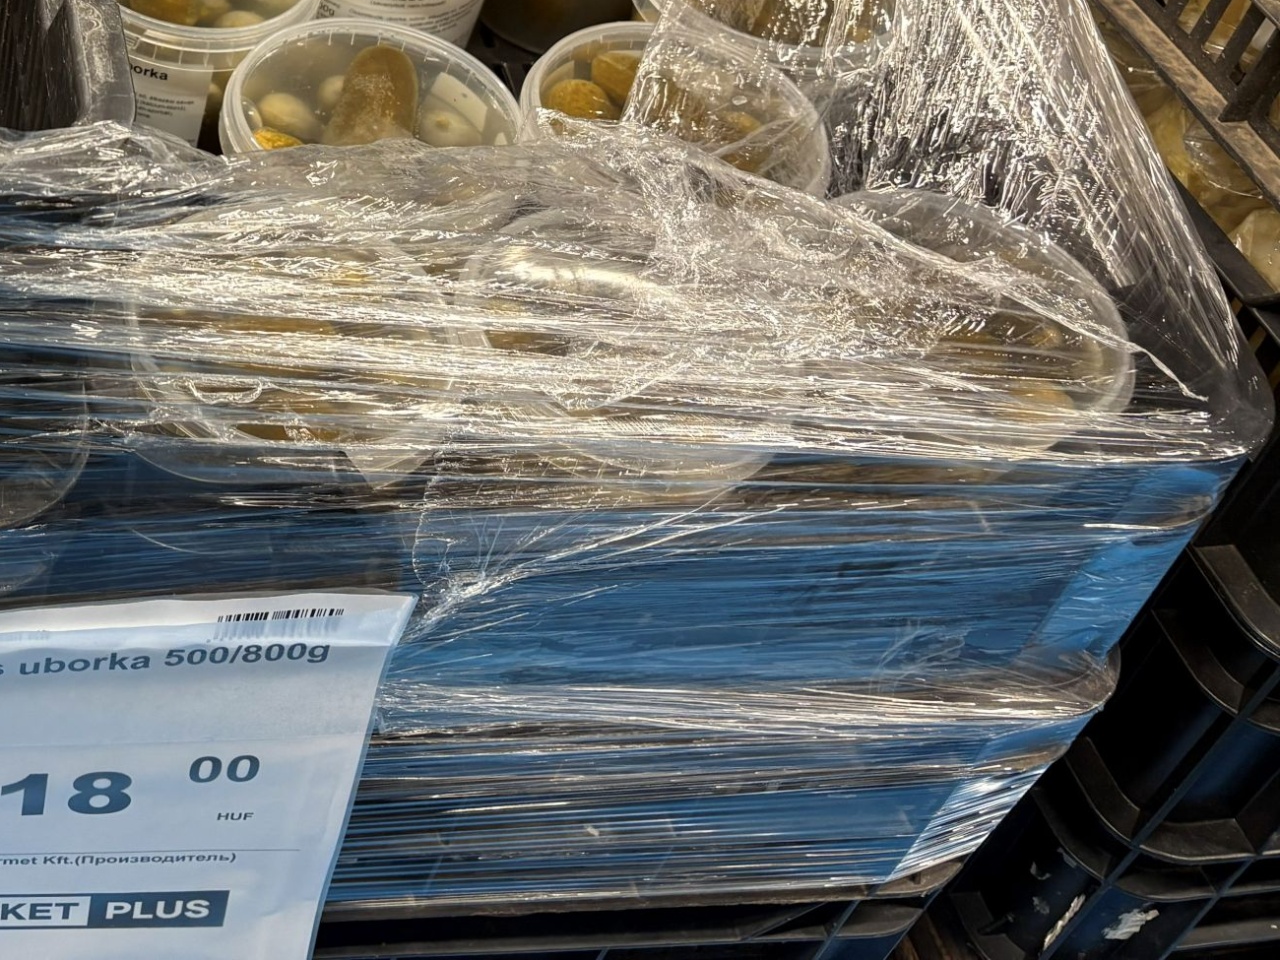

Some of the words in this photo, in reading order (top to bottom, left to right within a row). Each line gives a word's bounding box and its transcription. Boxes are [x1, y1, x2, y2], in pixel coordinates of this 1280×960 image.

[130, 63, 168, 81] orka
[19, 652, 151, 676] uborka
[164, 642, 331, 668] 500/800g
[188, 754, 261, 784] 00
[216, 811, 255, 821] HUF
[104, 898, 210, 920] PLUS
